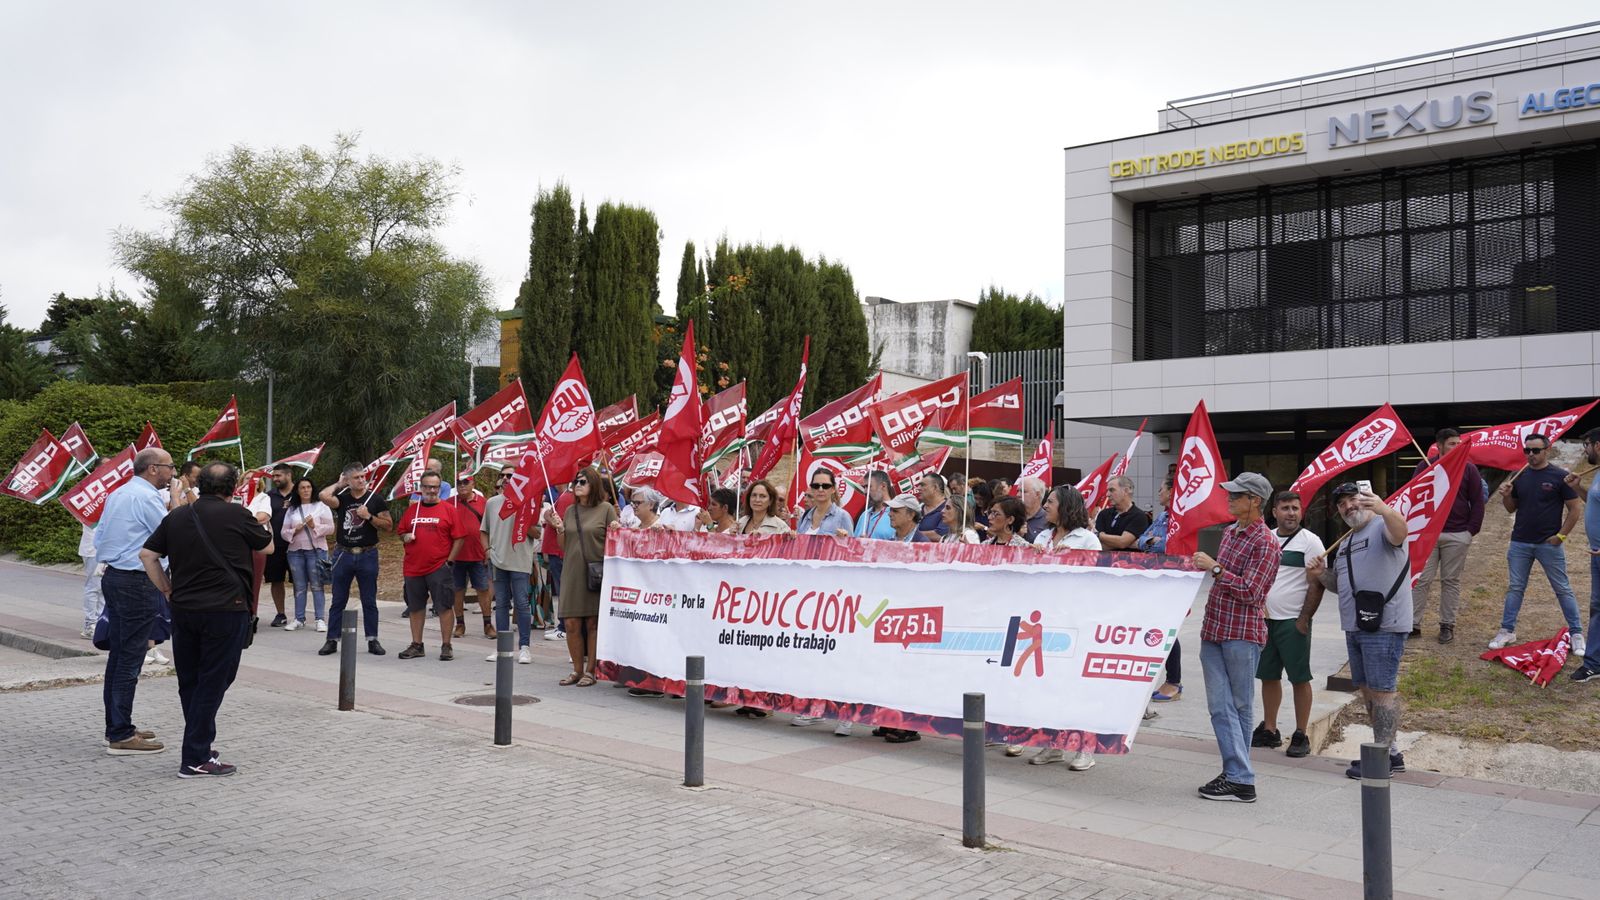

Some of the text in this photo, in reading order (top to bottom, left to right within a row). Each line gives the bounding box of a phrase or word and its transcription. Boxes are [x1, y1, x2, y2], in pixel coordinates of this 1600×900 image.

[1521, 83, 1600, 114] ALGEC
[1328, 91, 1494, 147] NEXUS
[1209, 132, 1305, 163] NEGOCIOS
[643, 592, 664, 605] UGT
[681, 594, 705, 609] Por la
[712, 580, 862, 634] REDUCCIÓN
[880, 613, 919, 639] 37,5
[1094, 624, 1142, 645] UGT
[718, 629, 836, 654] del tiempo de trabajo
